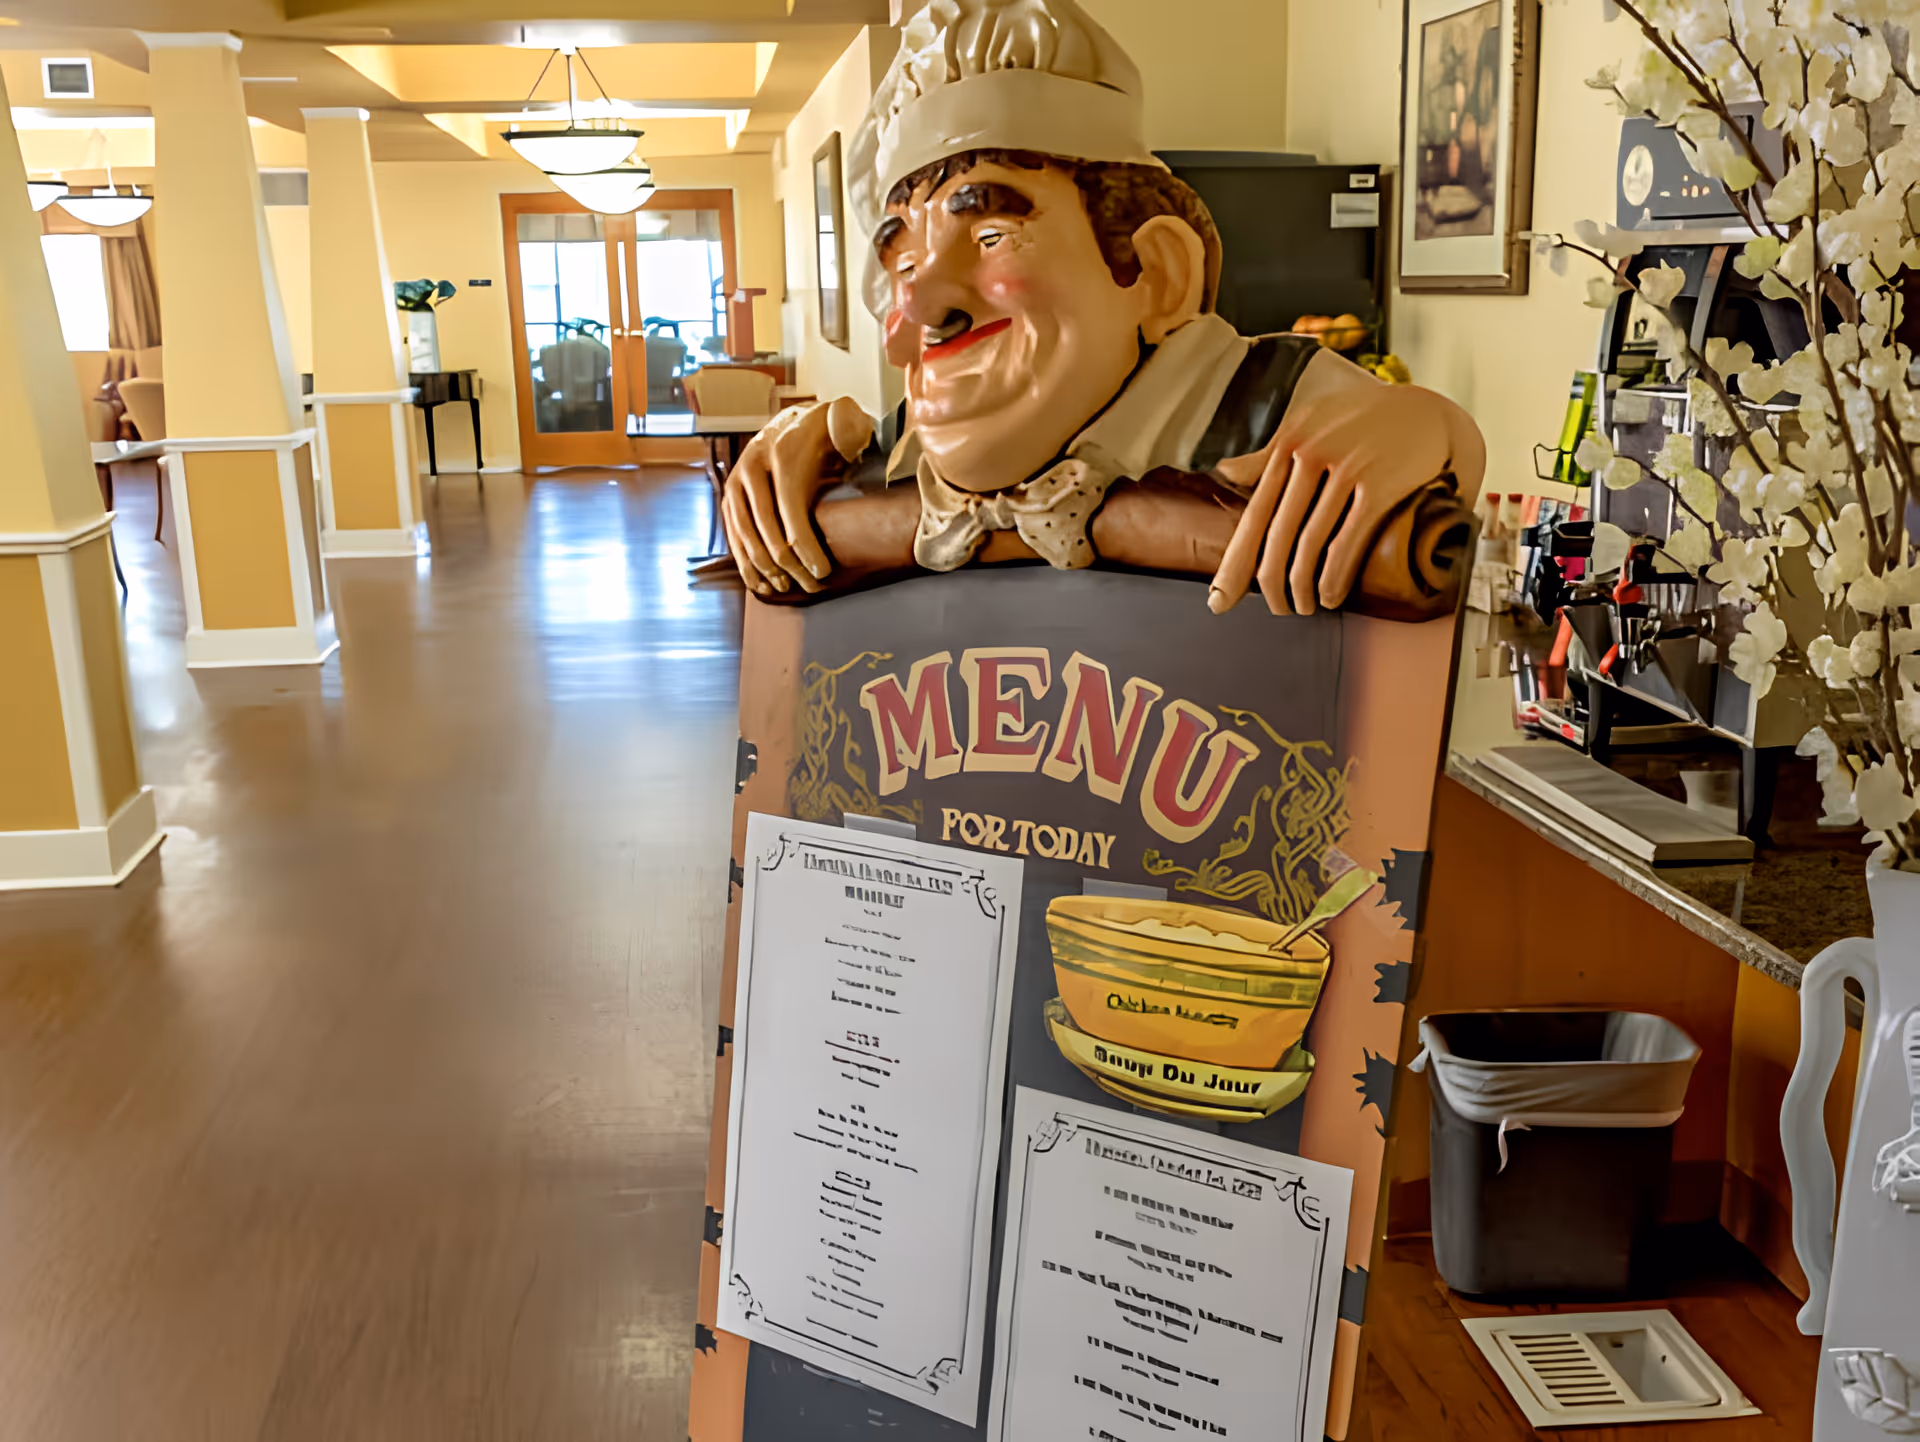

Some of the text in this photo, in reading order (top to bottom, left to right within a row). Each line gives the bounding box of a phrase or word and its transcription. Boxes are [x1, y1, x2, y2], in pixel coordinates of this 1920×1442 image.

[860, 647, 1260, 843] MENU
[1012, 820, 1116, 869] TODAY
[1163, 1063, 1195, 1085] Du
